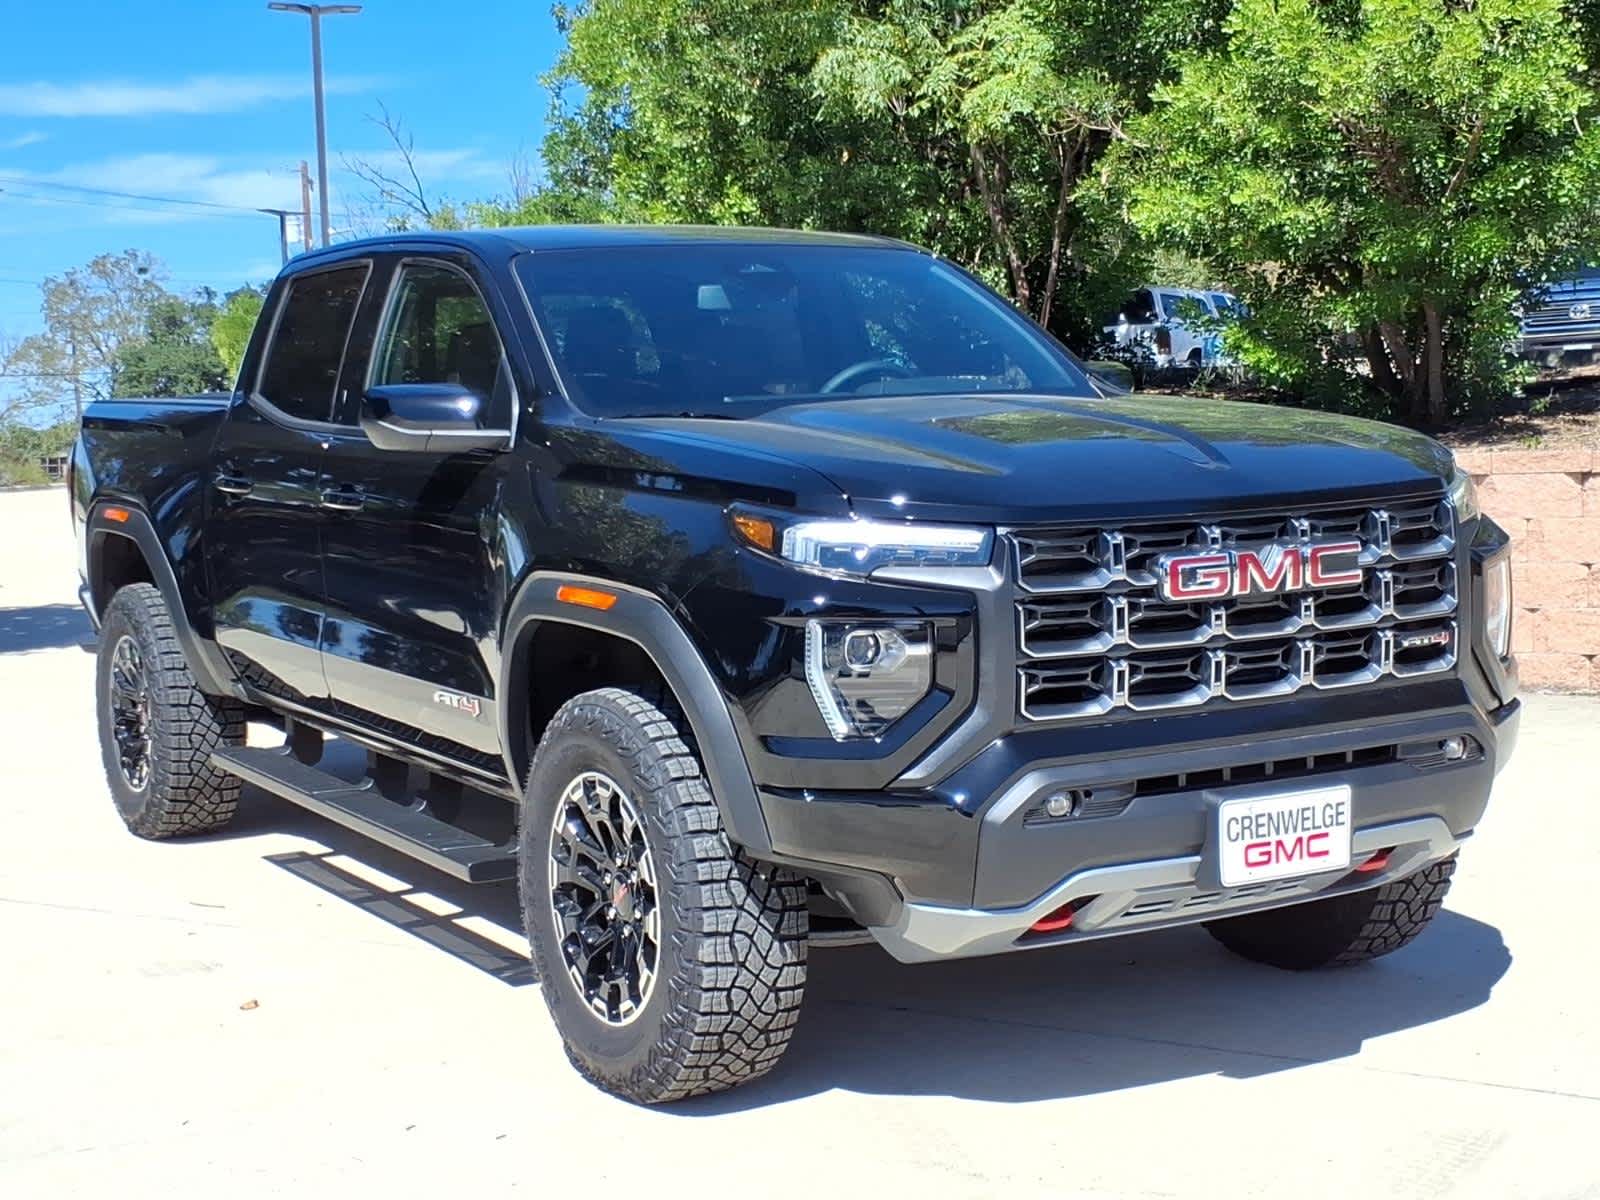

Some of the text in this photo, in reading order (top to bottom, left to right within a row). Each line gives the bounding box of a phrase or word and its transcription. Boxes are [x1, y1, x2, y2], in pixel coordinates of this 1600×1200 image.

[1166, 541, 1363, 600] GMC
[1226, 801, 1346, 842] CRENWELGE
[1244, 832, 1330, 868] GMC
